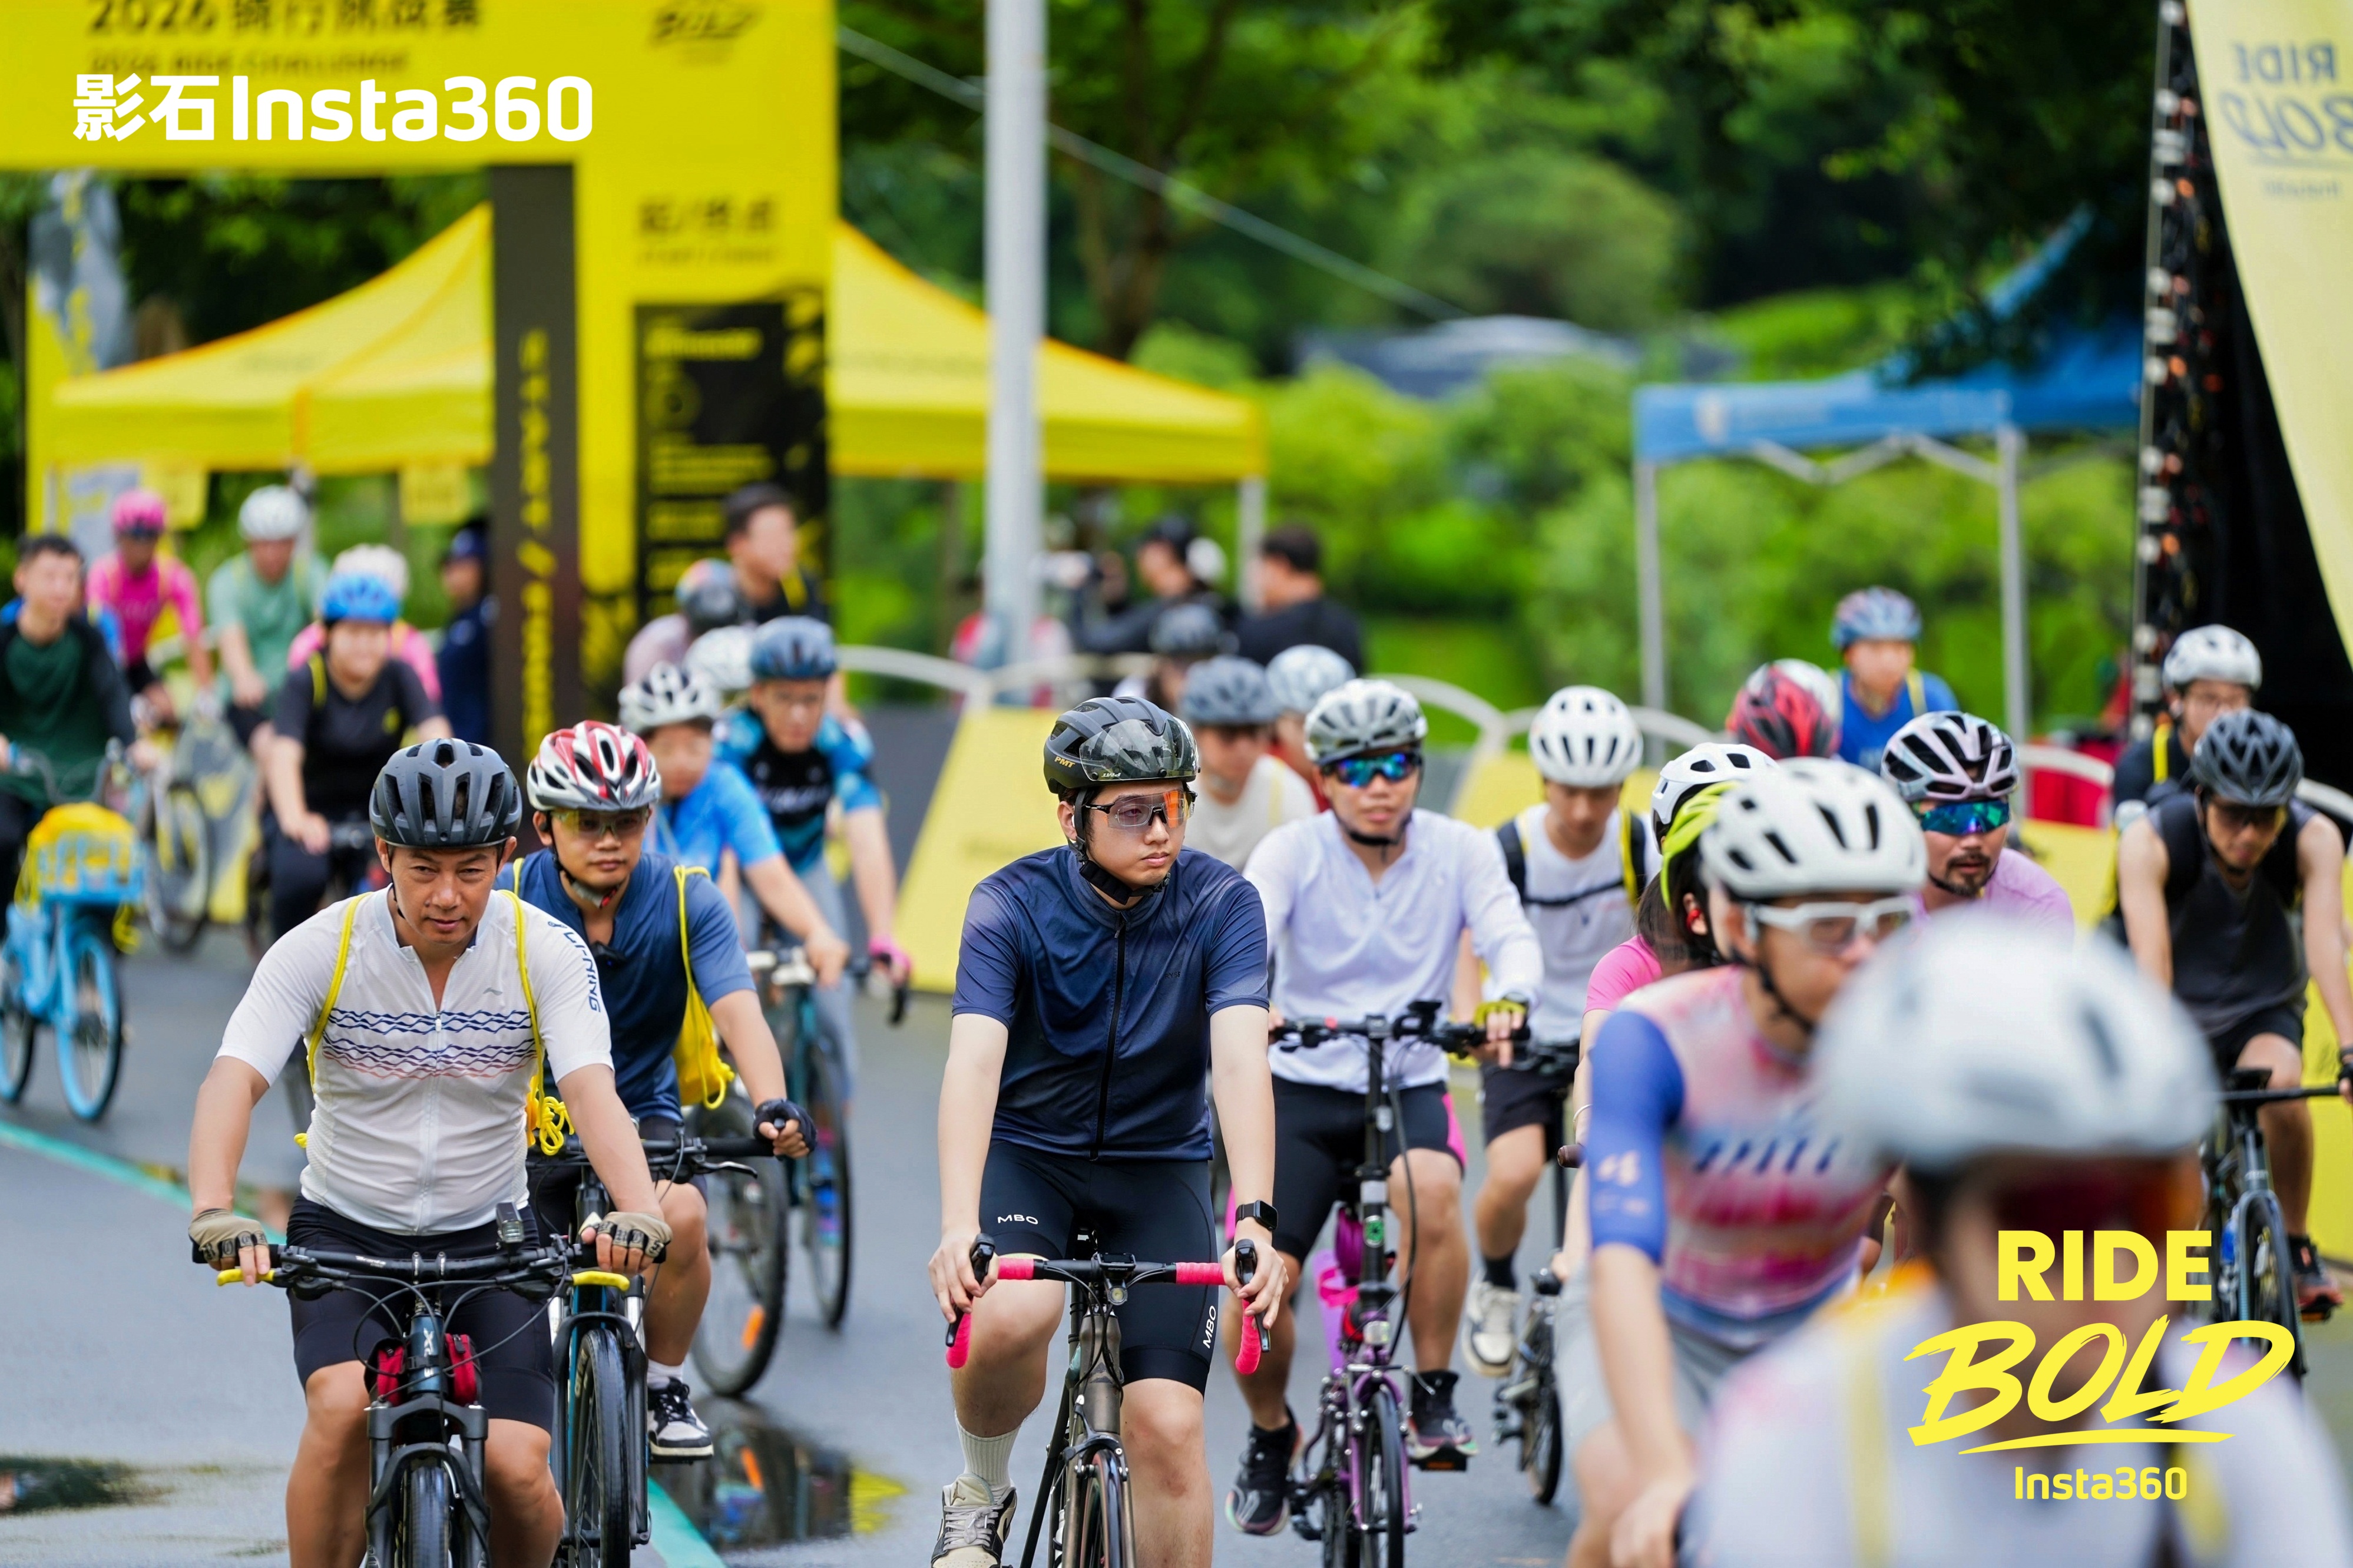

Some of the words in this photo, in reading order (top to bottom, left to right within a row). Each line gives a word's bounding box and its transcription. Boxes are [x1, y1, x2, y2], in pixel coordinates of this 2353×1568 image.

[1054, 756, 1075, 768] PMT
[997, 1214, 1038, 1225] MBO
[1203, 1305, 1216, 1349] MBO
